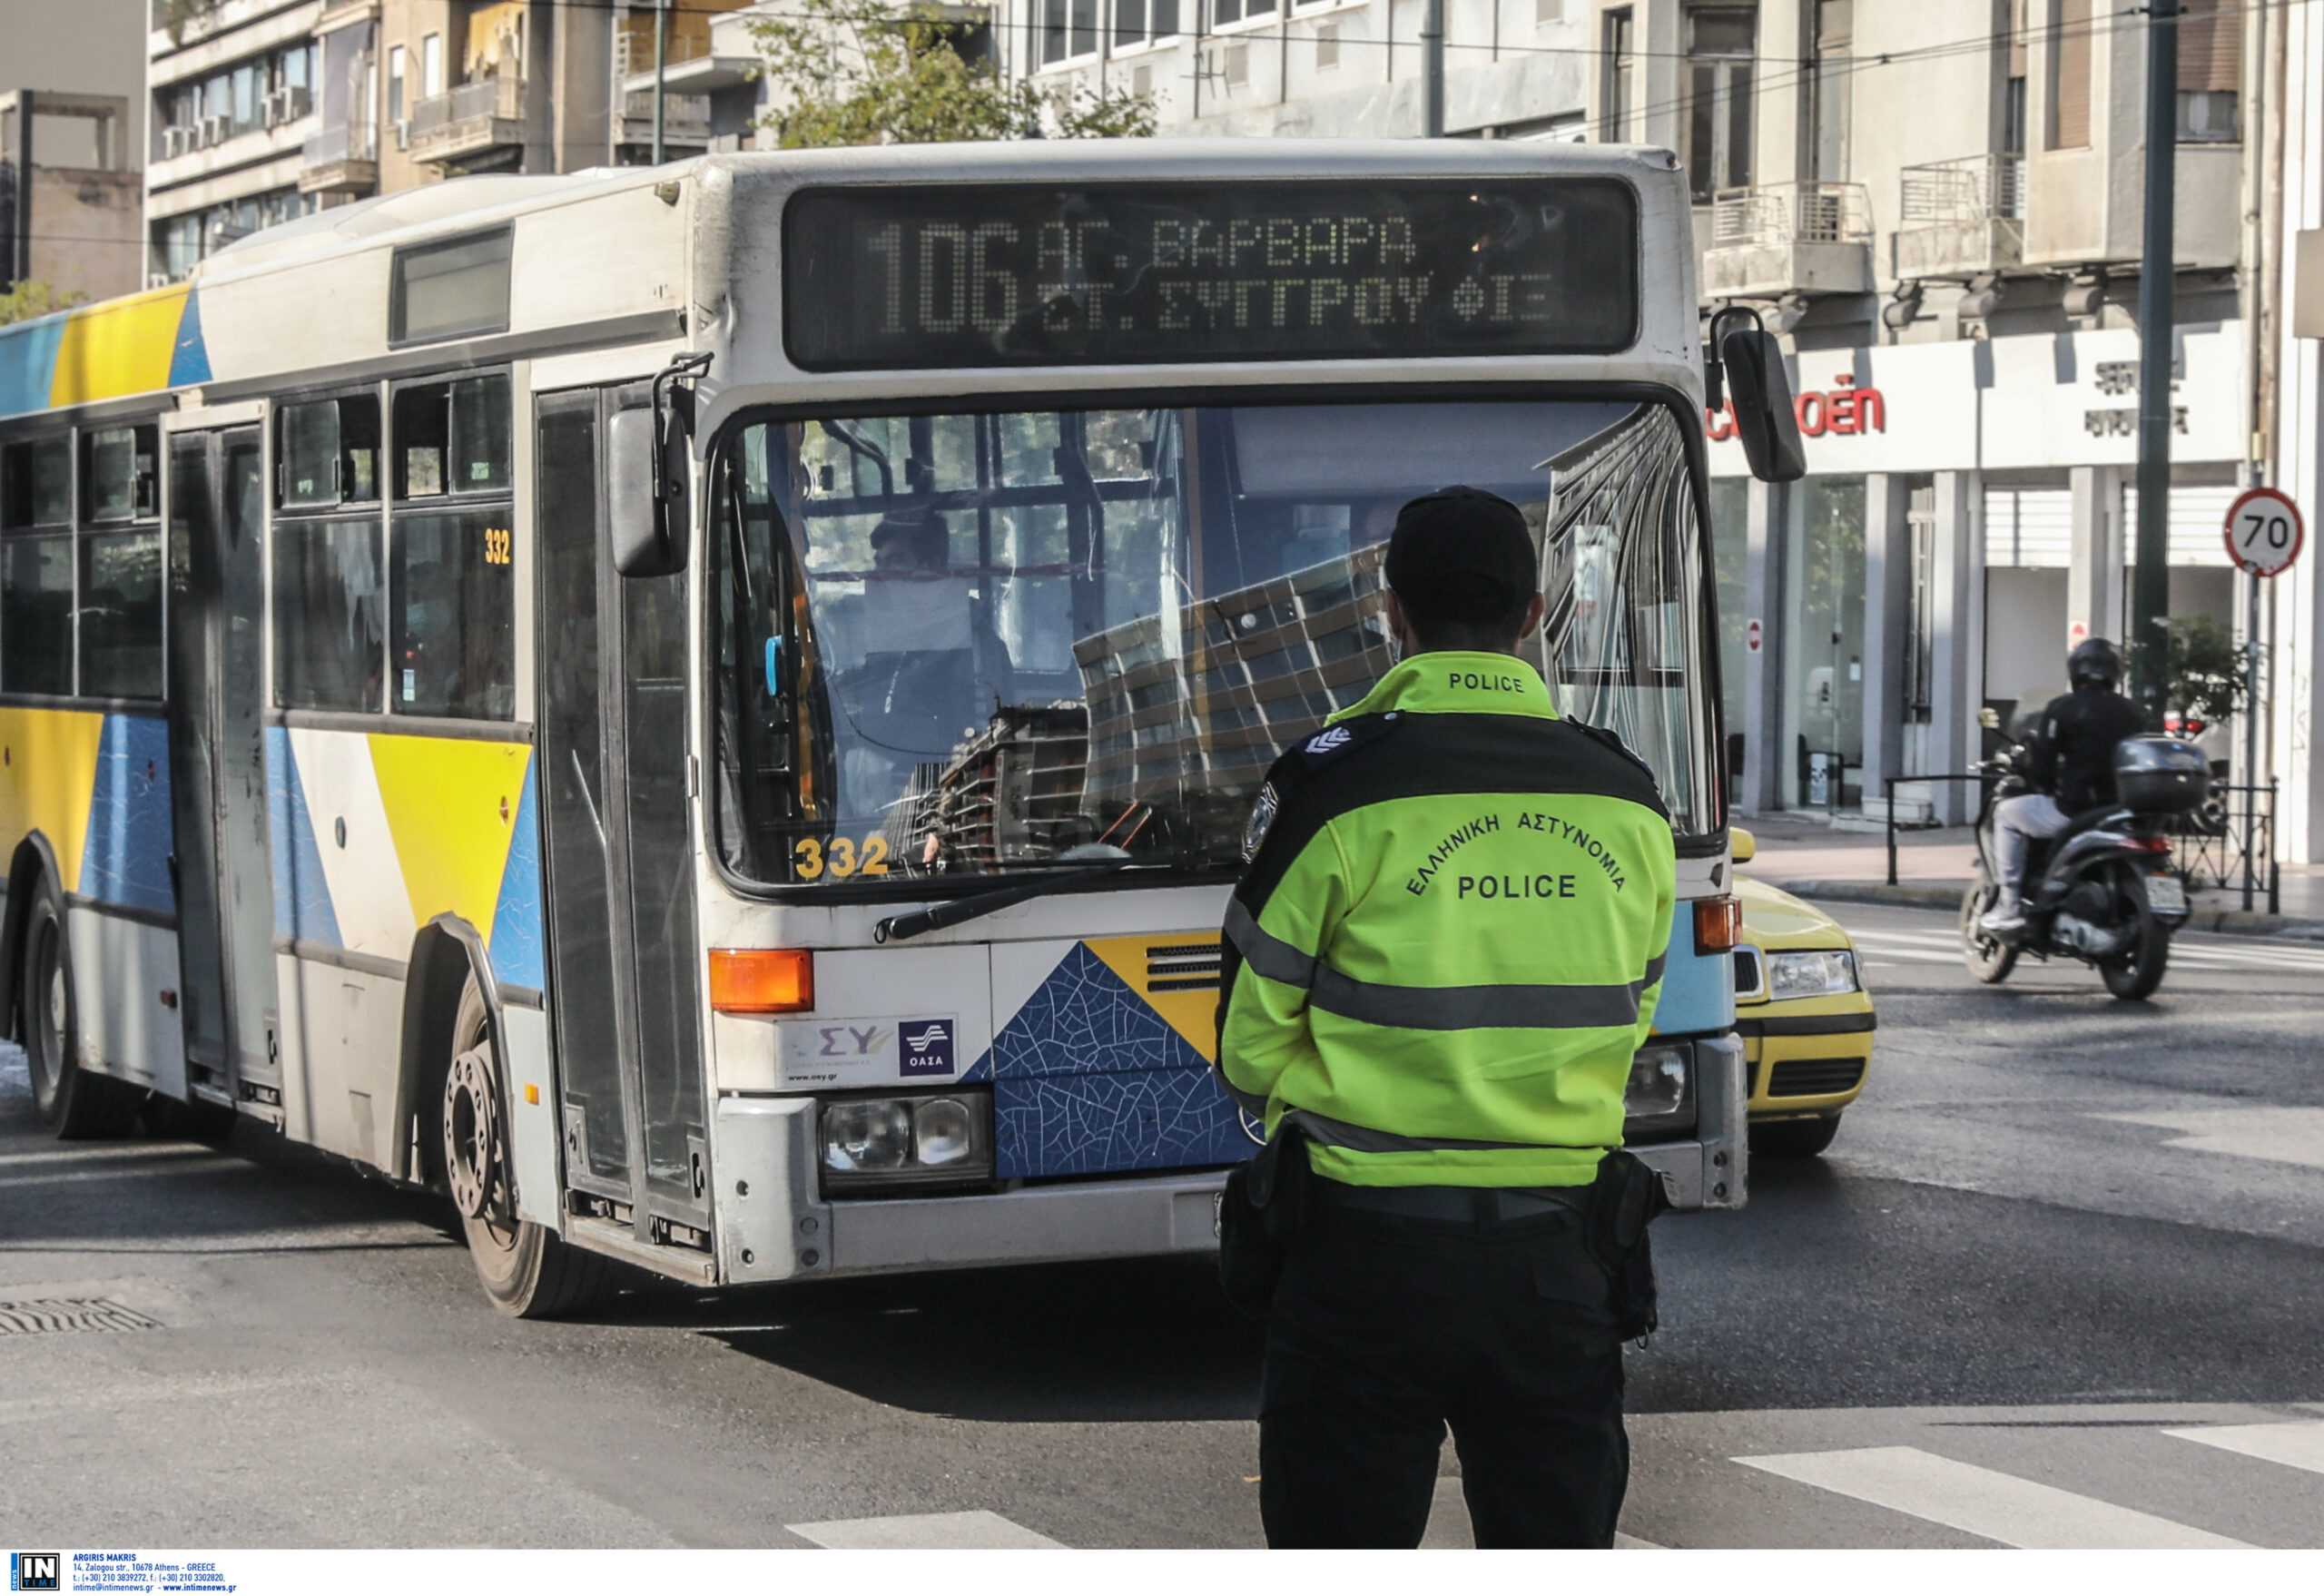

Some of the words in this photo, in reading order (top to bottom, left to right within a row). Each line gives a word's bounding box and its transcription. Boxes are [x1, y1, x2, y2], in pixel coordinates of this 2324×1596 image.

[1038, 221, 1128, 270] ΑΓ.
[1154, 217, 1416, 268] ΒΑΡΒΑΡΑ
[867, 223, 1019, 333] 106
[1158, 276, 1429, 328] ΣΥΓΓΡΟΥ
[1452, 274, 1552, 322] ΦΙΞ
[485, 527, 510, 565] 332
[2244, 515, 2289, 549] 70
[1450, 673, 1525, 694] POLICE
[795, 836, 889, 879] 332
[1405, 814, 1501, 897] ΕΛΛΗΝΙΚΗ
[1517, 812, 1626, 893] ΑΣΤΥΝΟΜΙΑ
[1458, 874, 1576, 899] POLICE
[788, 1073, 837, 1082] www.osy.gr
[910, 1057, 943, 1067] ΟΑΣΑ
